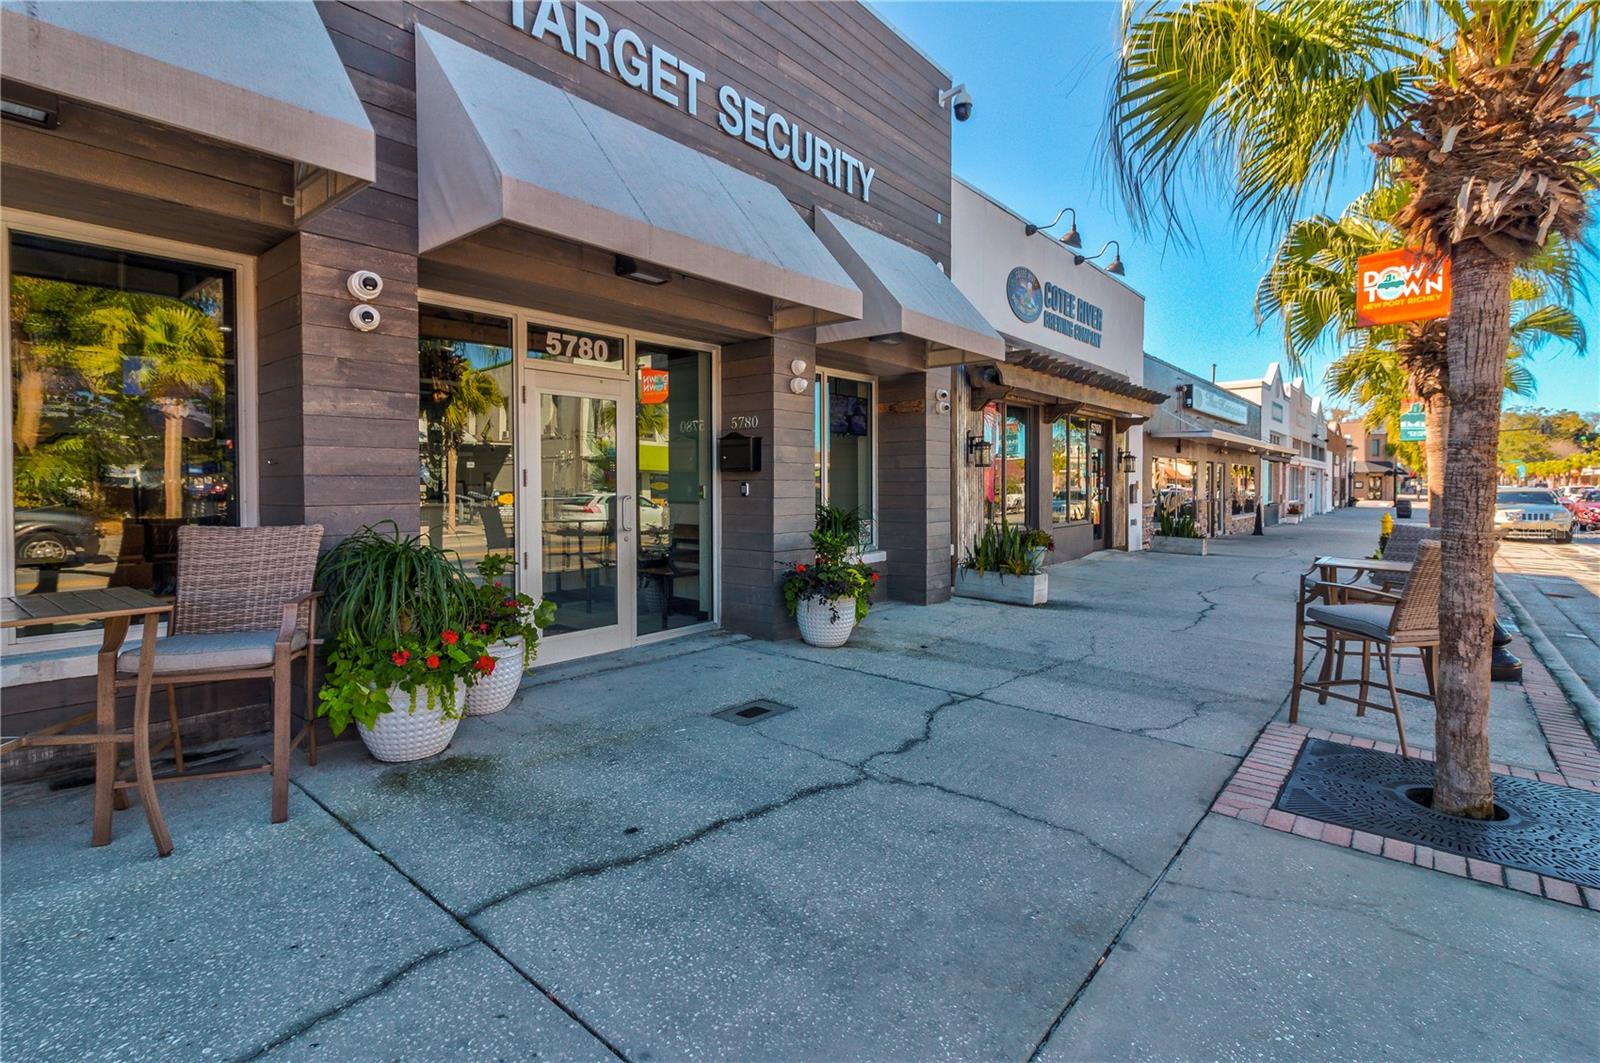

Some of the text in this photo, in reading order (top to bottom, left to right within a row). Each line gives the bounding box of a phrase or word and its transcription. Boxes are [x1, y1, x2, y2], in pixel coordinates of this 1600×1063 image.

[718, 85, 875, 203] SECURITY
[1363, 294, 1442, 310] NEW PORT RICHEY
[1364, 275, 1443, 303] TOWN
[1044, 281, 1103, 332] COTEE RIVER
[1043, 310, 1102, 349] BREWING COMPANY
[546, 331, 608, 362] 5780
[731, 416, 759, 430] 5780
